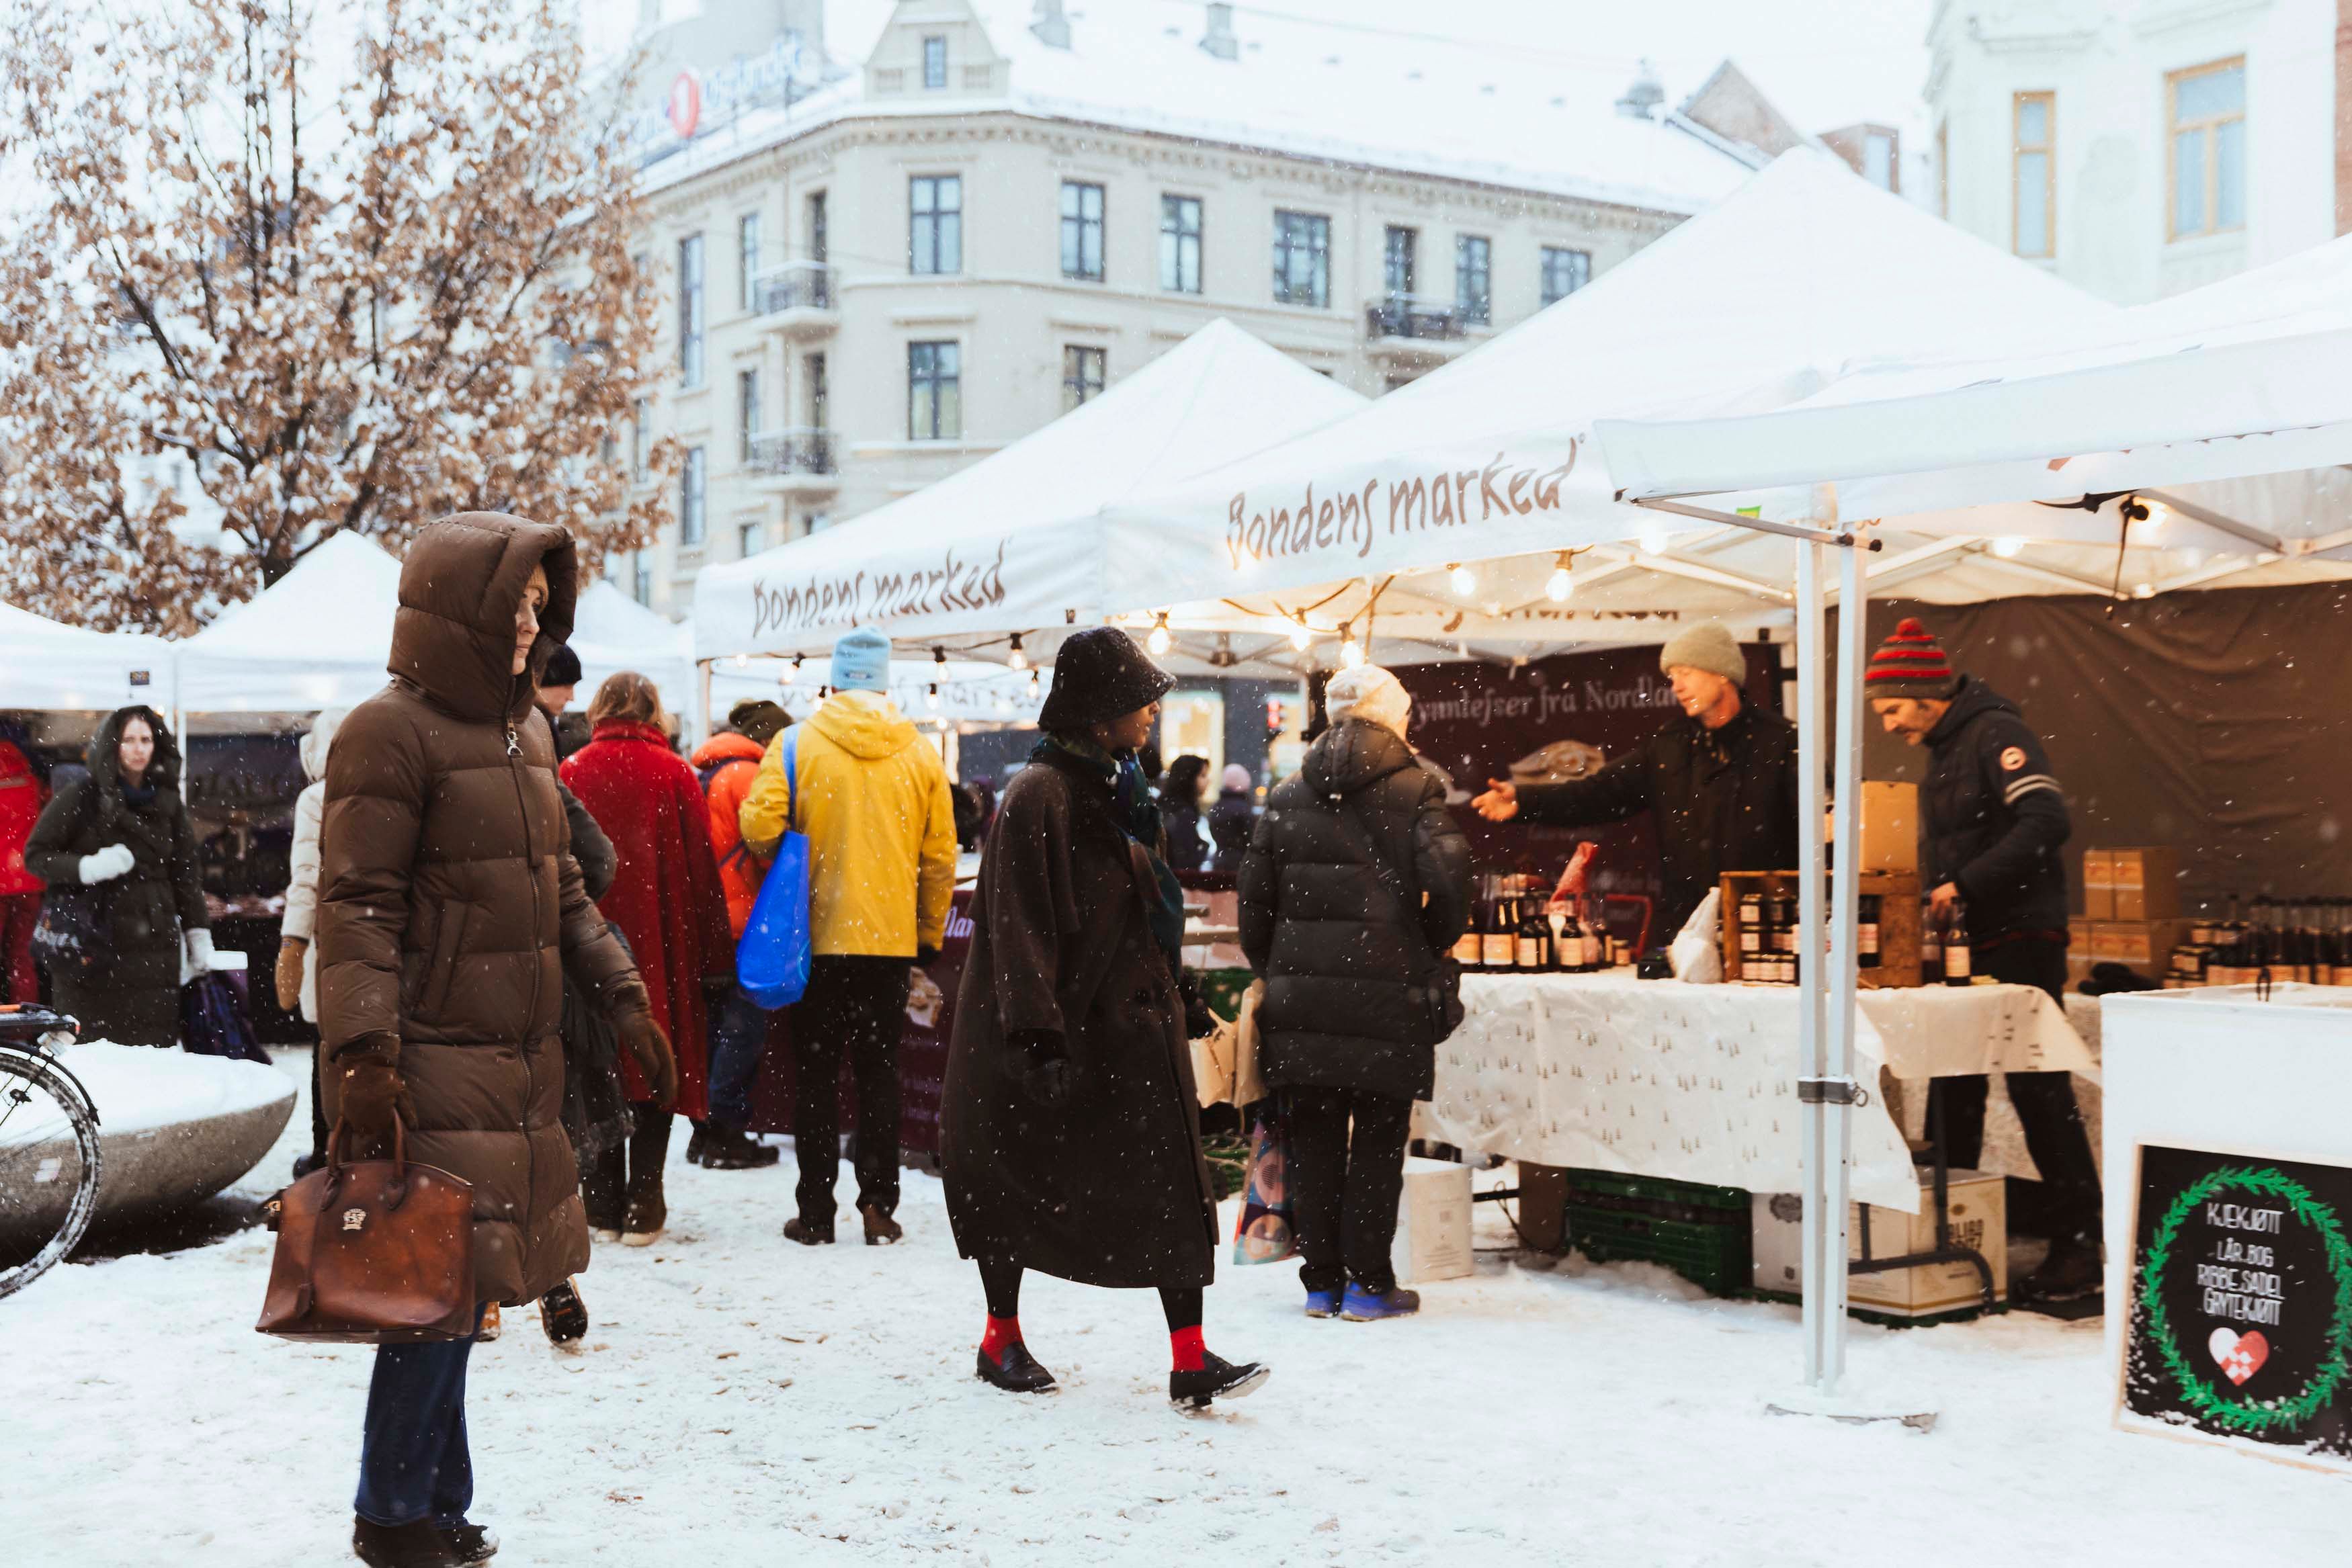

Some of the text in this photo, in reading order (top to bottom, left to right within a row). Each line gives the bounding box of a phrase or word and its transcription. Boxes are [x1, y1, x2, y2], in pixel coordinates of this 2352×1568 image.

[1389, 437, 1577, 535] marked
[867, 539, 1006, 618] marked
[1536, 685, 1577, 724] fra
